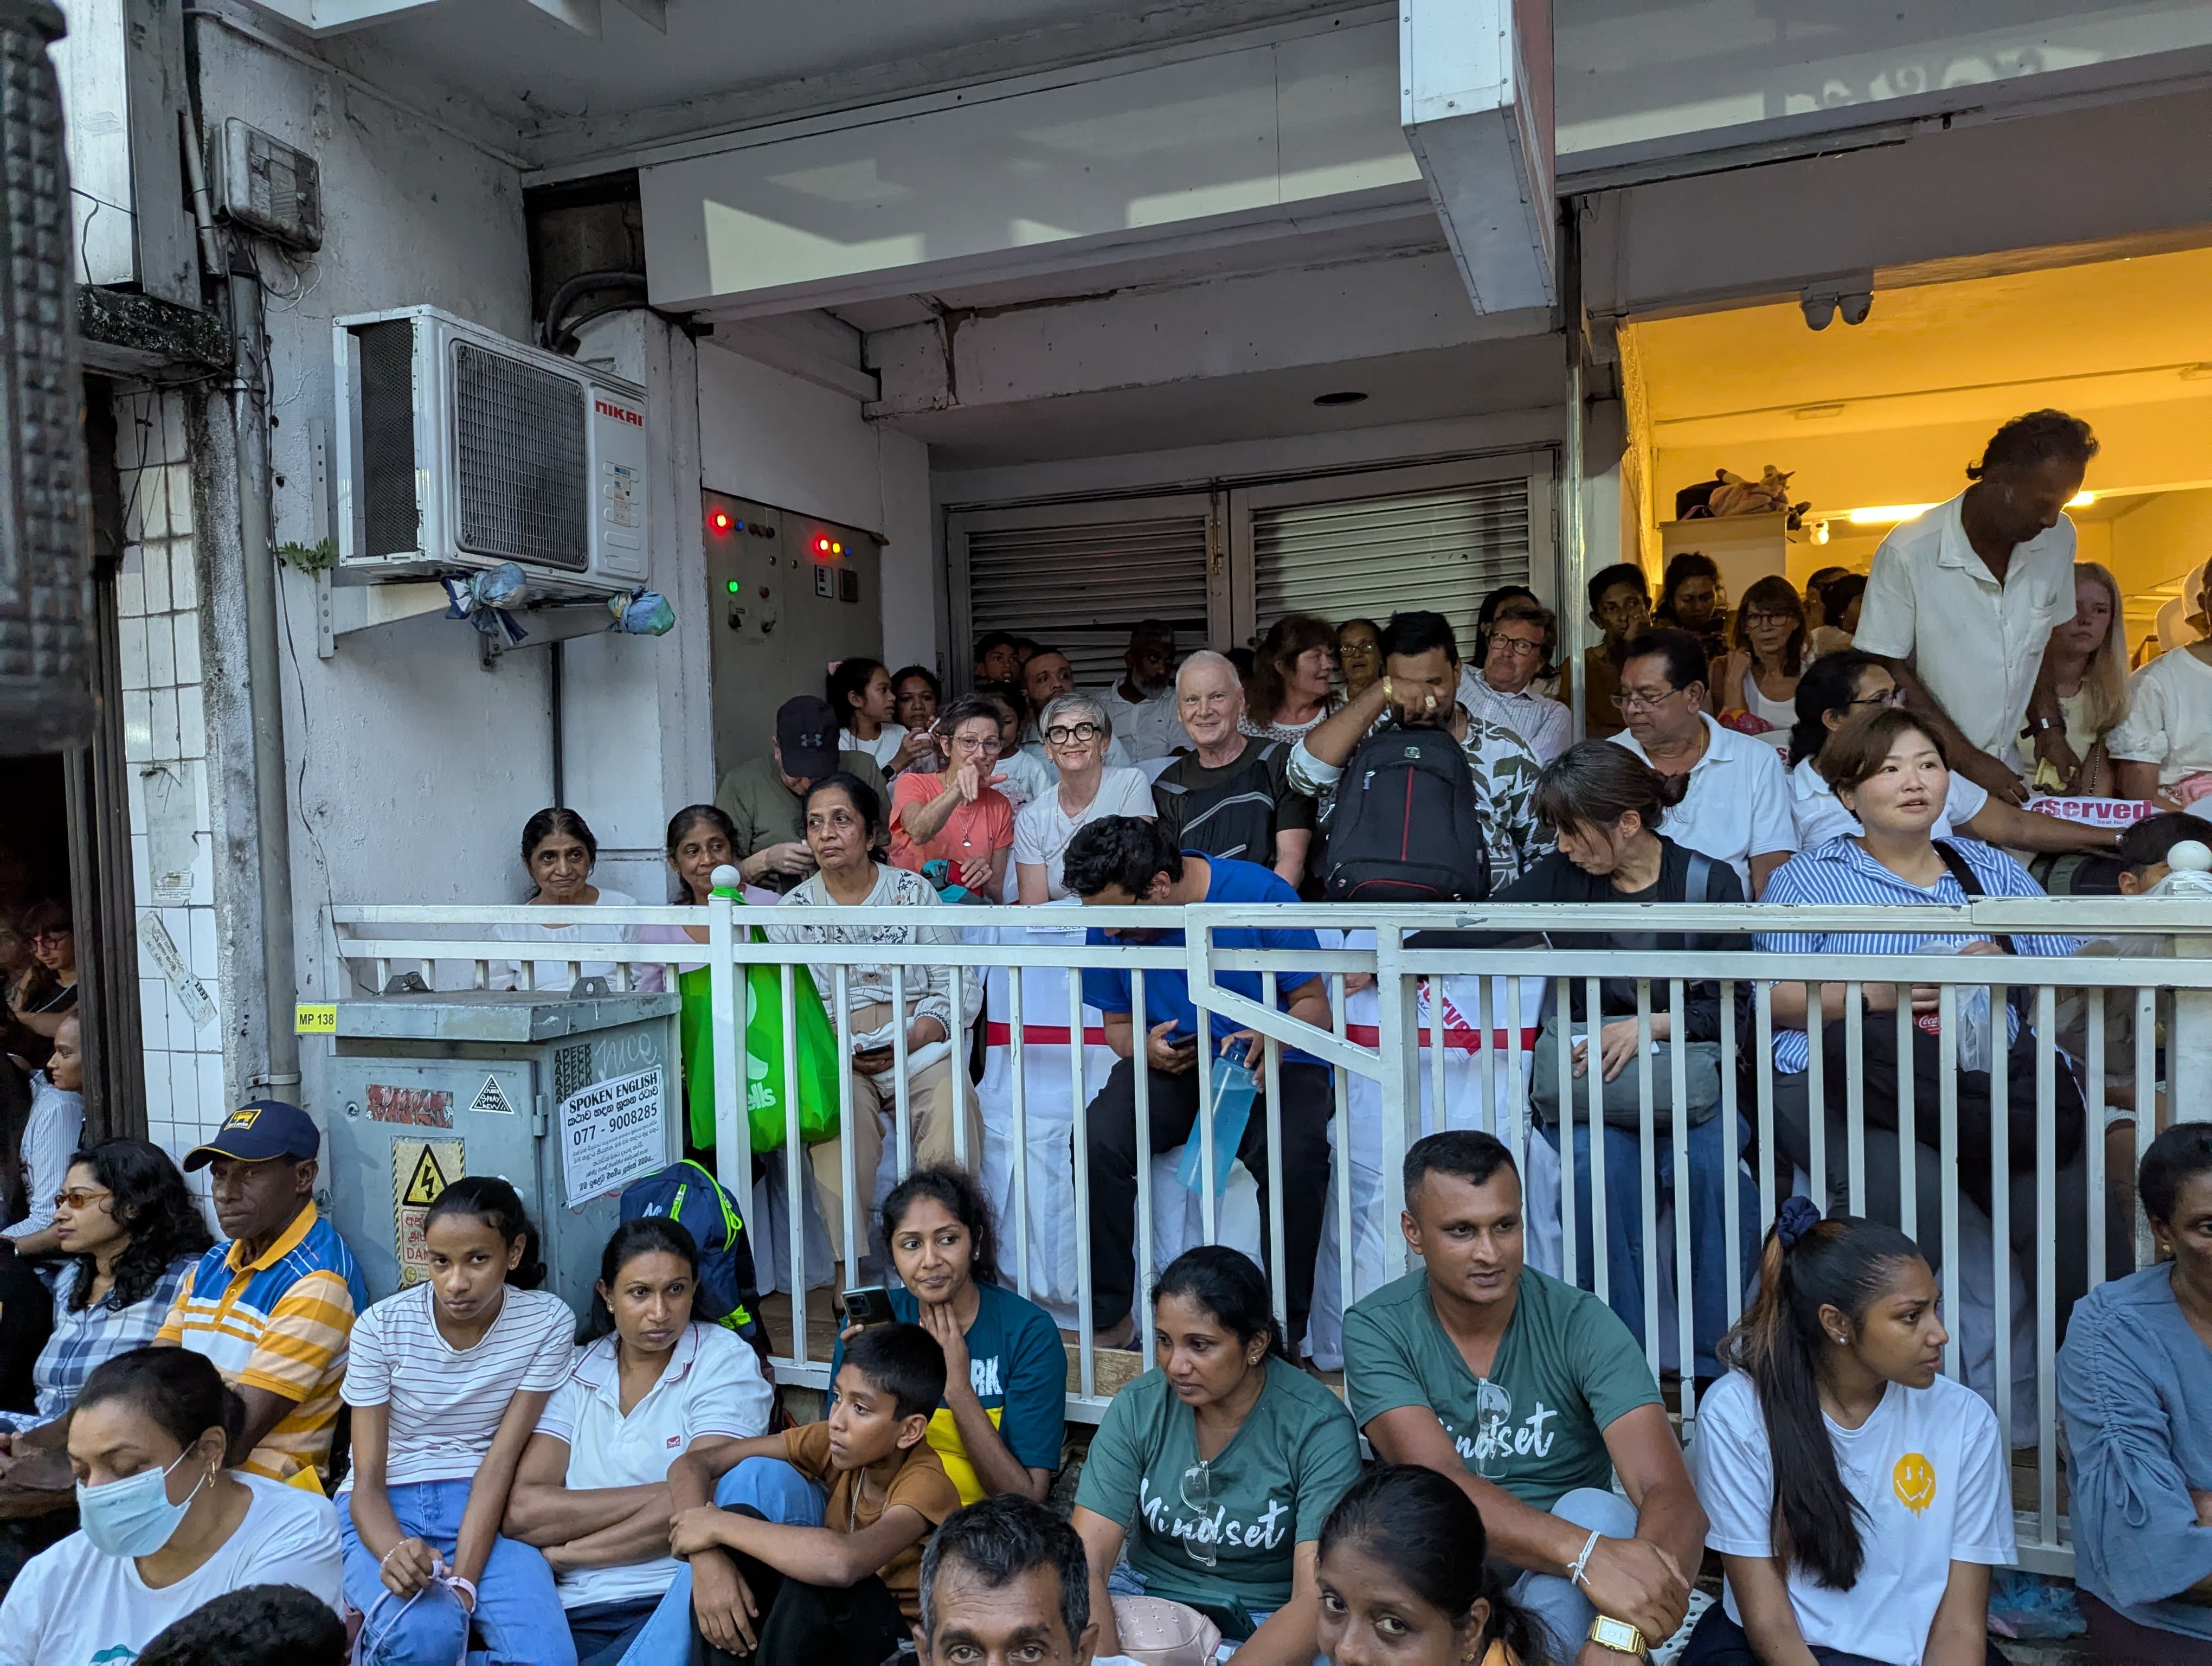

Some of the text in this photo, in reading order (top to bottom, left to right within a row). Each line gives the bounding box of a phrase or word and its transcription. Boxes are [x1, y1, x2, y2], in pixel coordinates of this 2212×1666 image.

[195, 981, 208, 1001] 1333
[299, 1014, 334, 1025] MP 138
[480, 1093, 500, 1104] SPRAY
[569, 1087, 613, 1113] SPOKEN
[616, 1072, 657, 1098] ENGLISH
[748, 1081, 776, 1111] ells
[574, 1125, 596, 1146] 077
[609, 1103, 657, 1133] 9008285
[407, 1247, 429, 1260] DAN
[970, 1355, 1003, 1396] RK
[1438, 1401, 1558, 1460] ndset
[1140, 1477, 1289, 1549] Mindset
